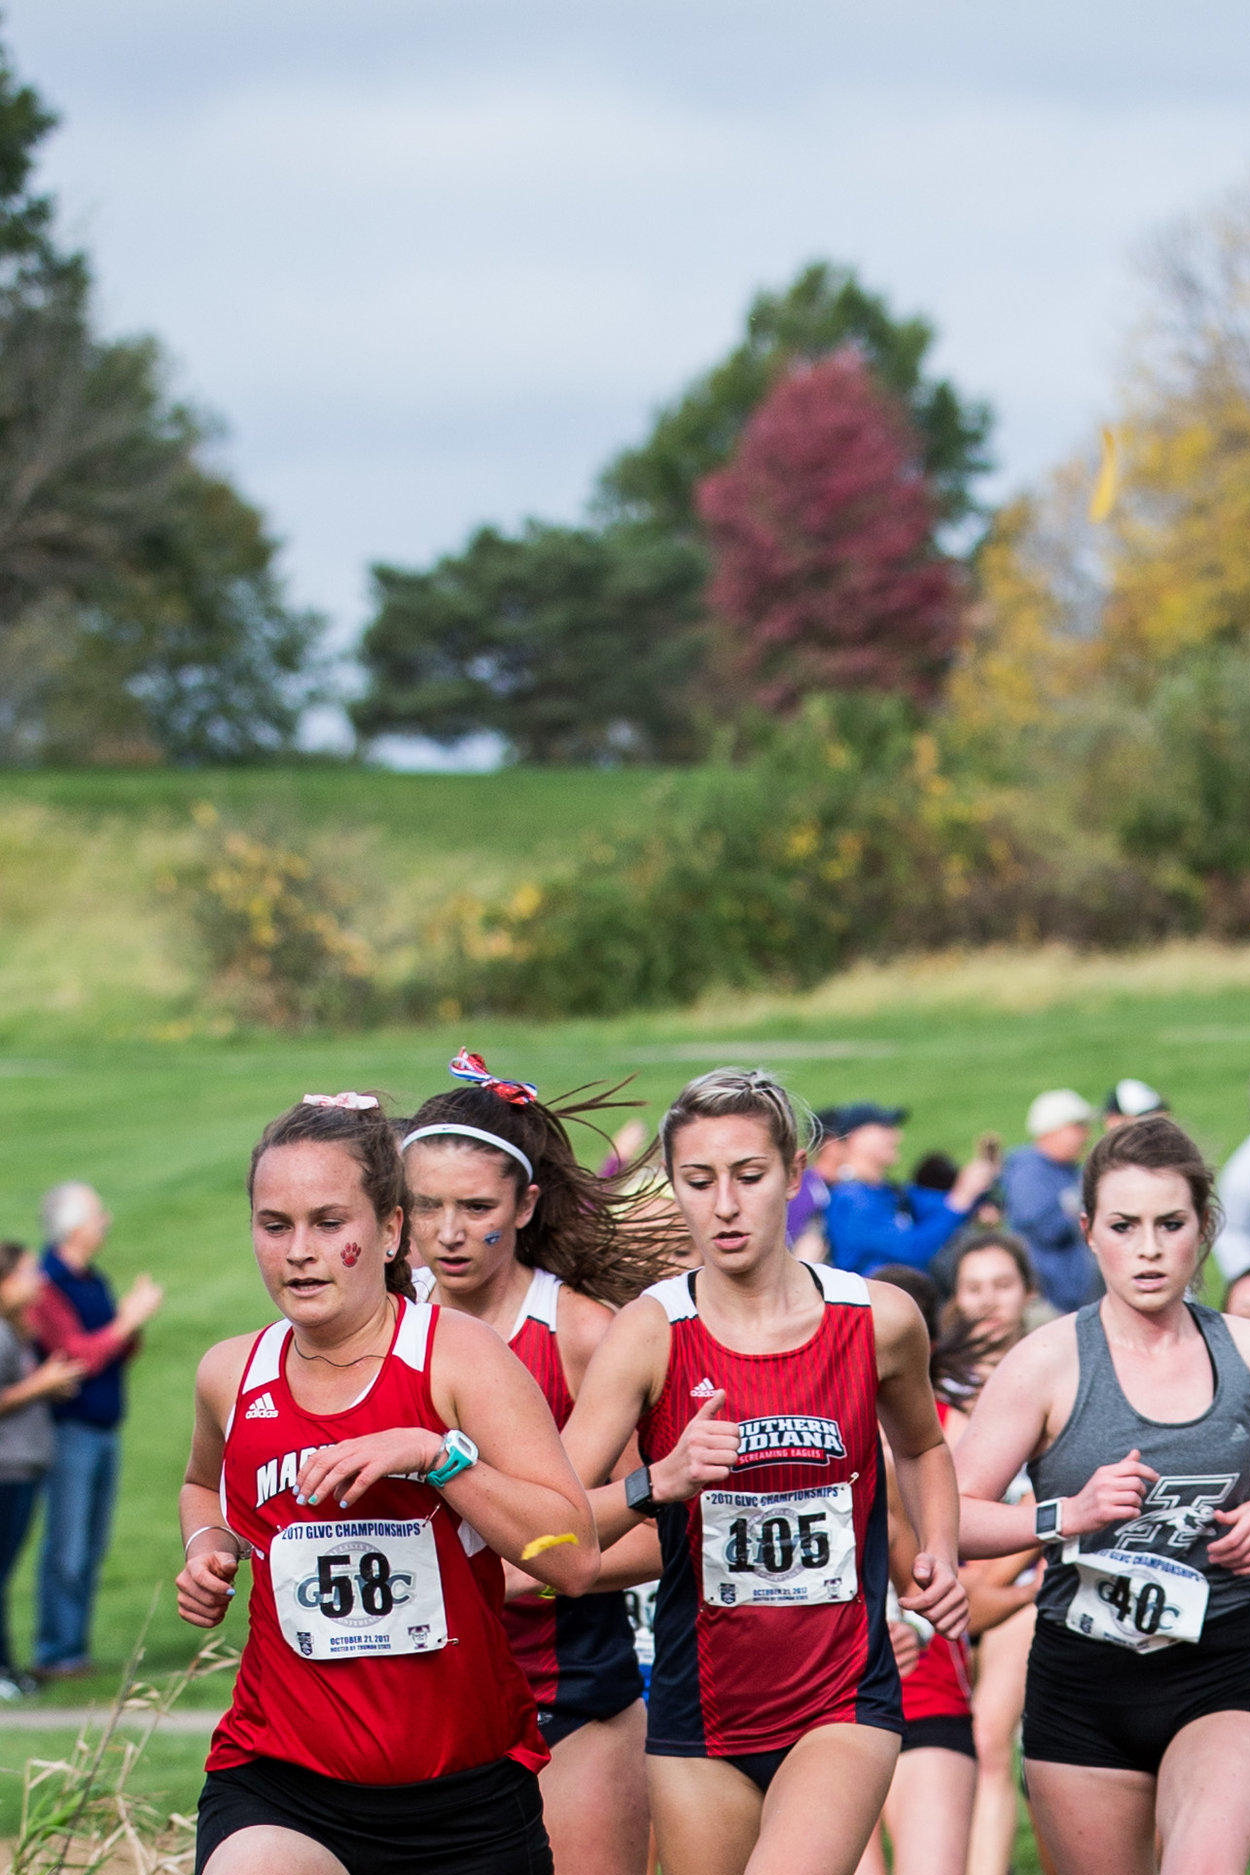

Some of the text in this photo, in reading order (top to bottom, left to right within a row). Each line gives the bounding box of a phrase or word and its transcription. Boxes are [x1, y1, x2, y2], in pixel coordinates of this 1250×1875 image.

[245, 1409, 279, 1420] adidas
[738, 1418, 838, 1437] UTHERN
[738, 1431, 843, 1453] NDIANA
[739, 1448, 821, 1465] SCREAMING EAGLES
[711, 1486, 839, 1508] 2017 GLVC CHAMPIONSHIPS
[281, 1522, 421, 1541] 2017 GLVC CHAMPIONSHIPS
[728, 1512, 831, 1573] 105
[317, 1552, 394, 1619] 58
[1111, 1575, 1166, 1635] 40
[329, 1635, 362, 1645] OCTOBER
[374, 1633, 390, 1643] 2017
